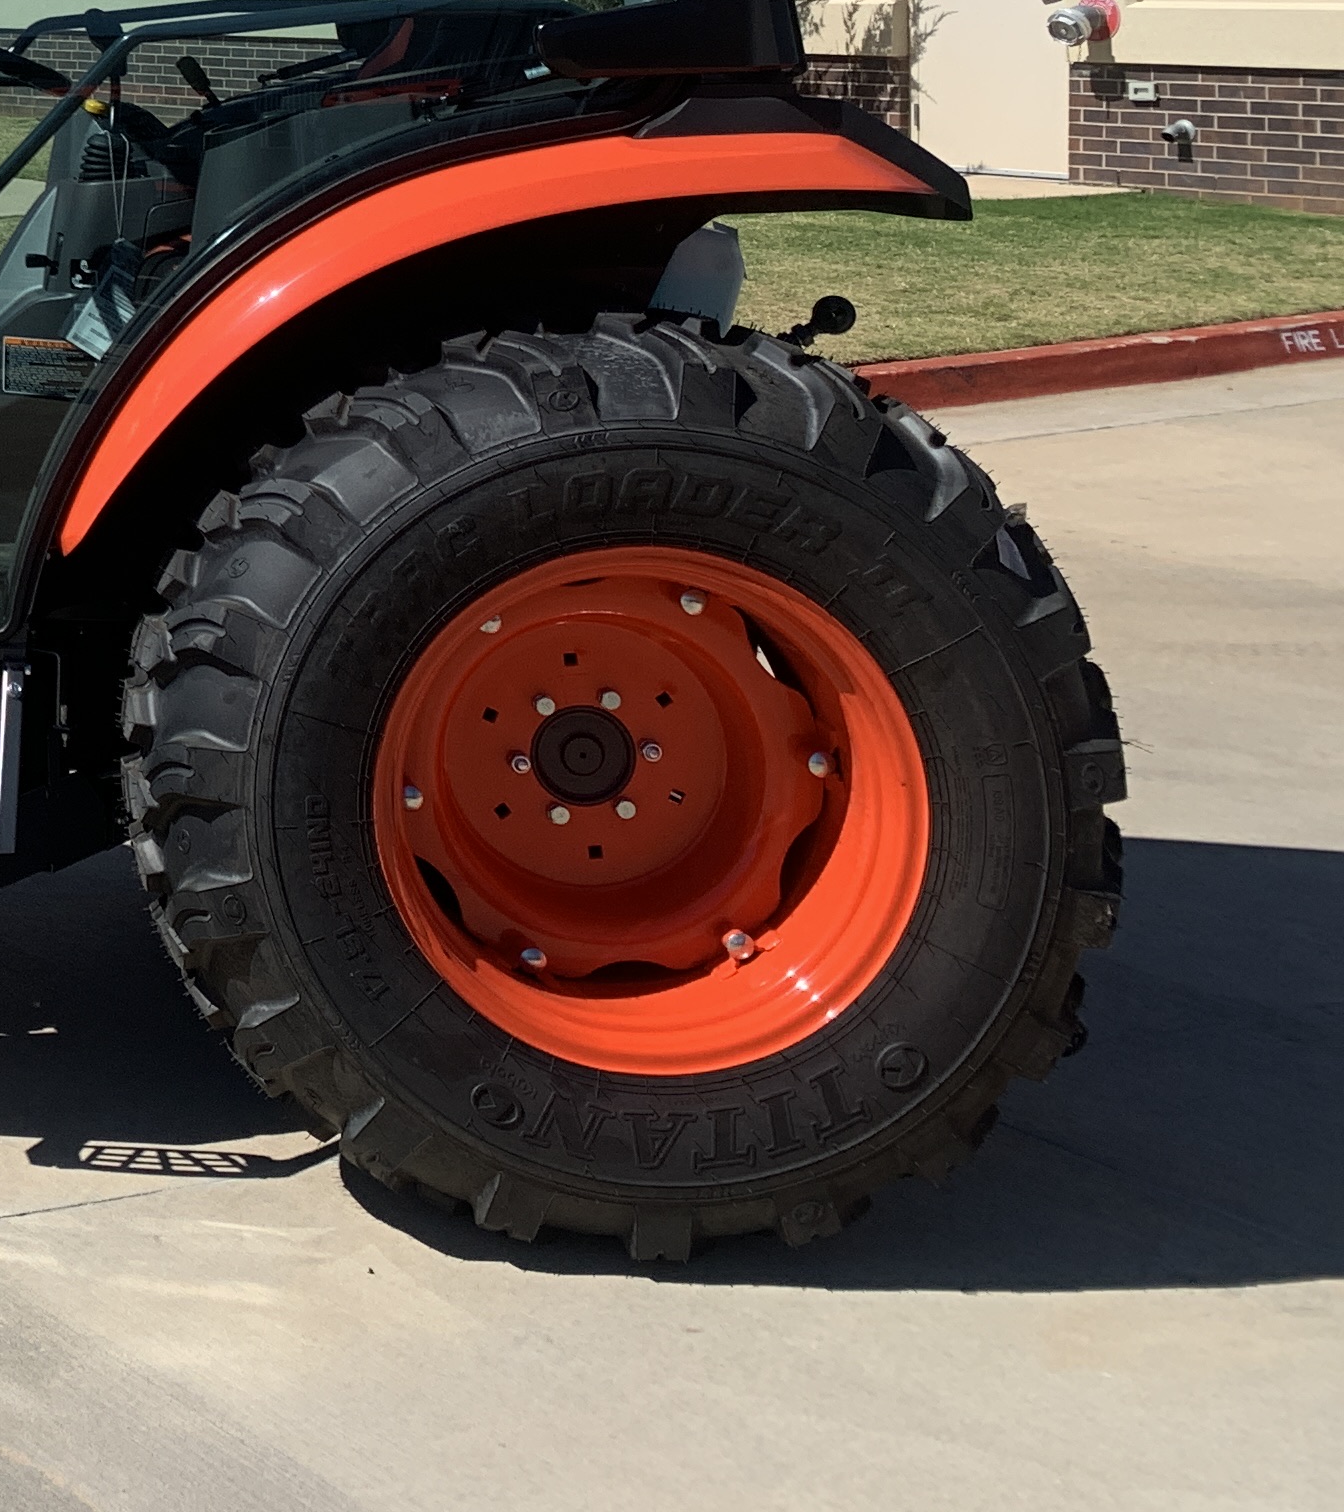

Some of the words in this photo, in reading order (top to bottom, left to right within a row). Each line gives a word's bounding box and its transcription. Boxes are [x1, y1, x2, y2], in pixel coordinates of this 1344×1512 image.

[1280, 329, 1326, 355] FIRE
[1329, 326, 1344, 349] L
[507, 469, 845, 554] LOADER
[523, 1064, 872, 1174] TITAN
